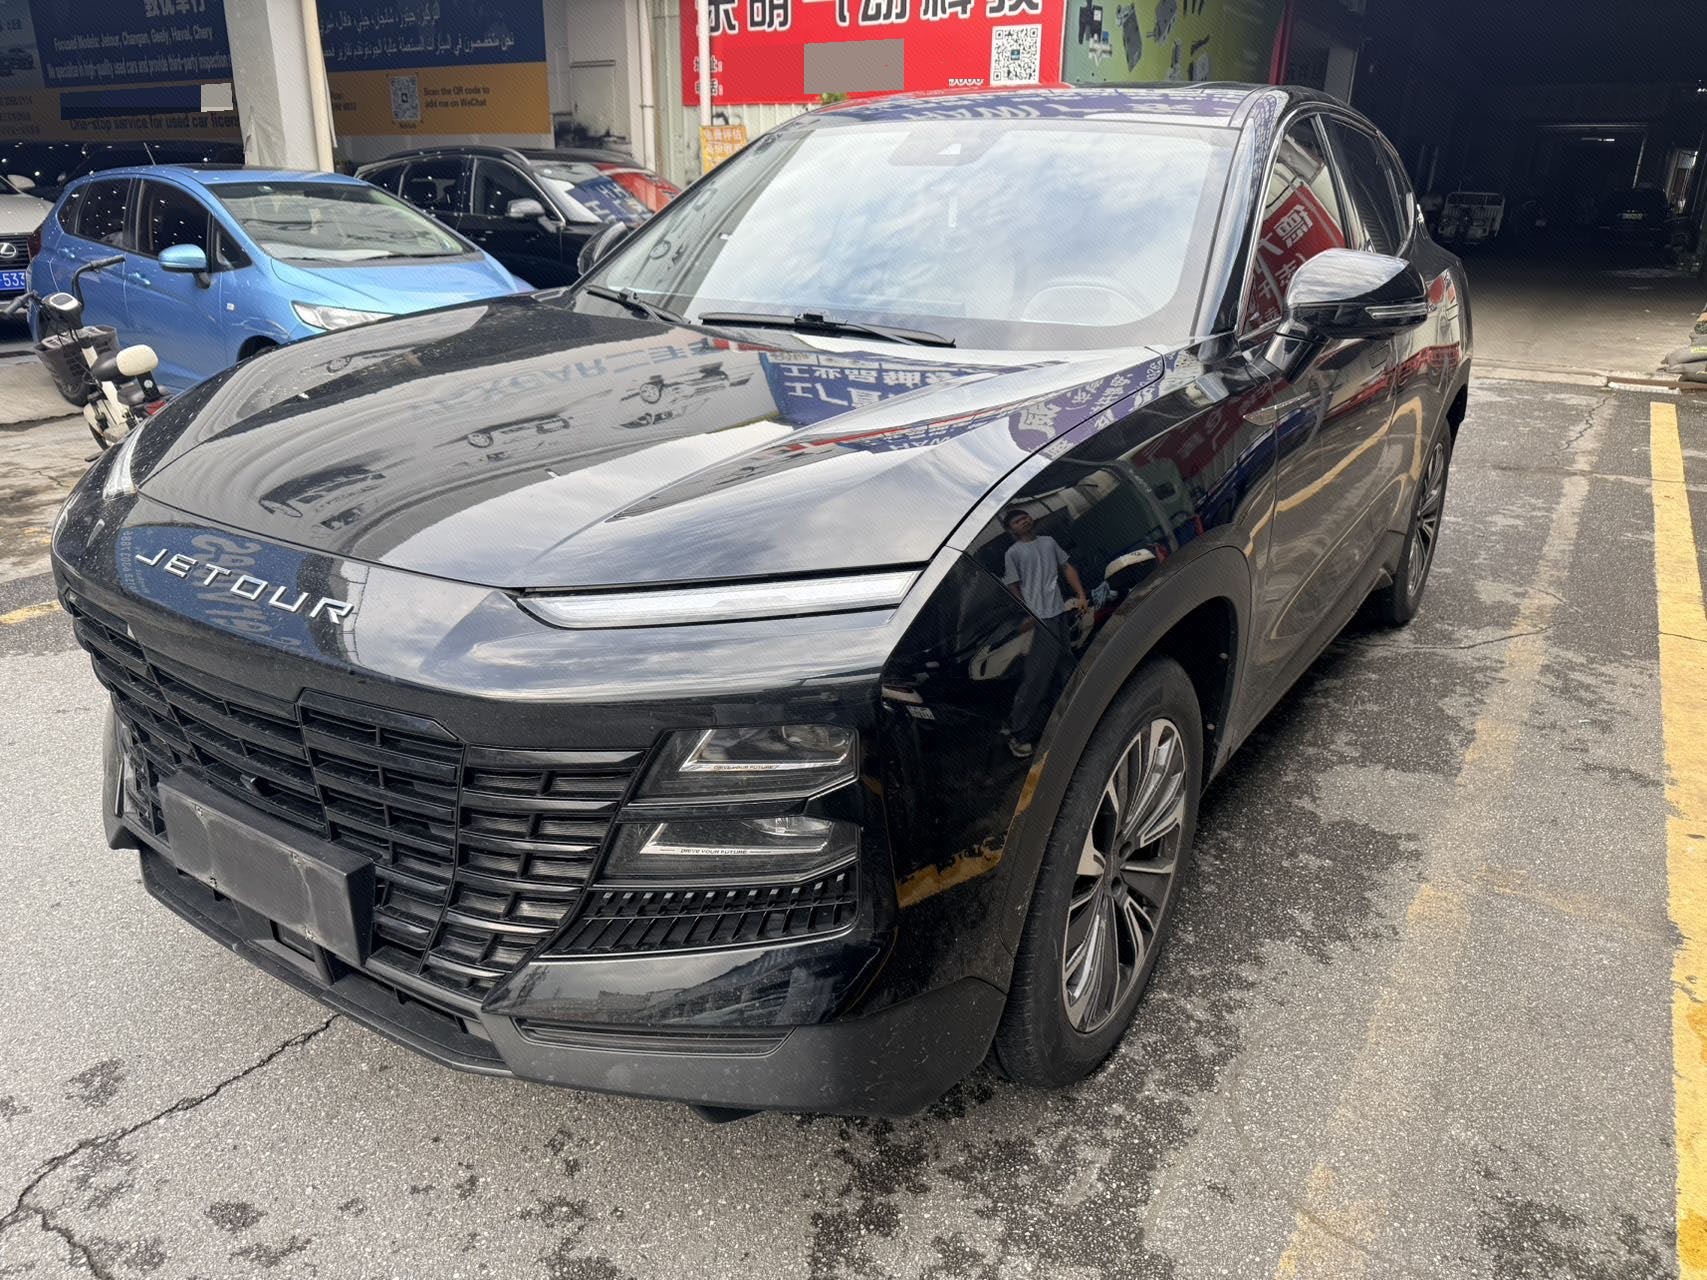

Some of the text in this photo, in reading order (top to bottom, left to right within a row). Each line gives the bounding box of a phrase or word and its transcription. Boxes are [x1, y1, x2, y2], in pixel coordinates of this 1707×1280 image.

[424, 85, 490, 96] Scan the QR code to
[425, 99, 437, 108] add
[450, 100, 459, 108] on
[461, 98, 487, 108] WeChat
[114, 116, 149, 129] service
[165, 113, 190, 128] used
[192, 115, 209, 127] car
[135, 548, 354, 625] JETOUR
